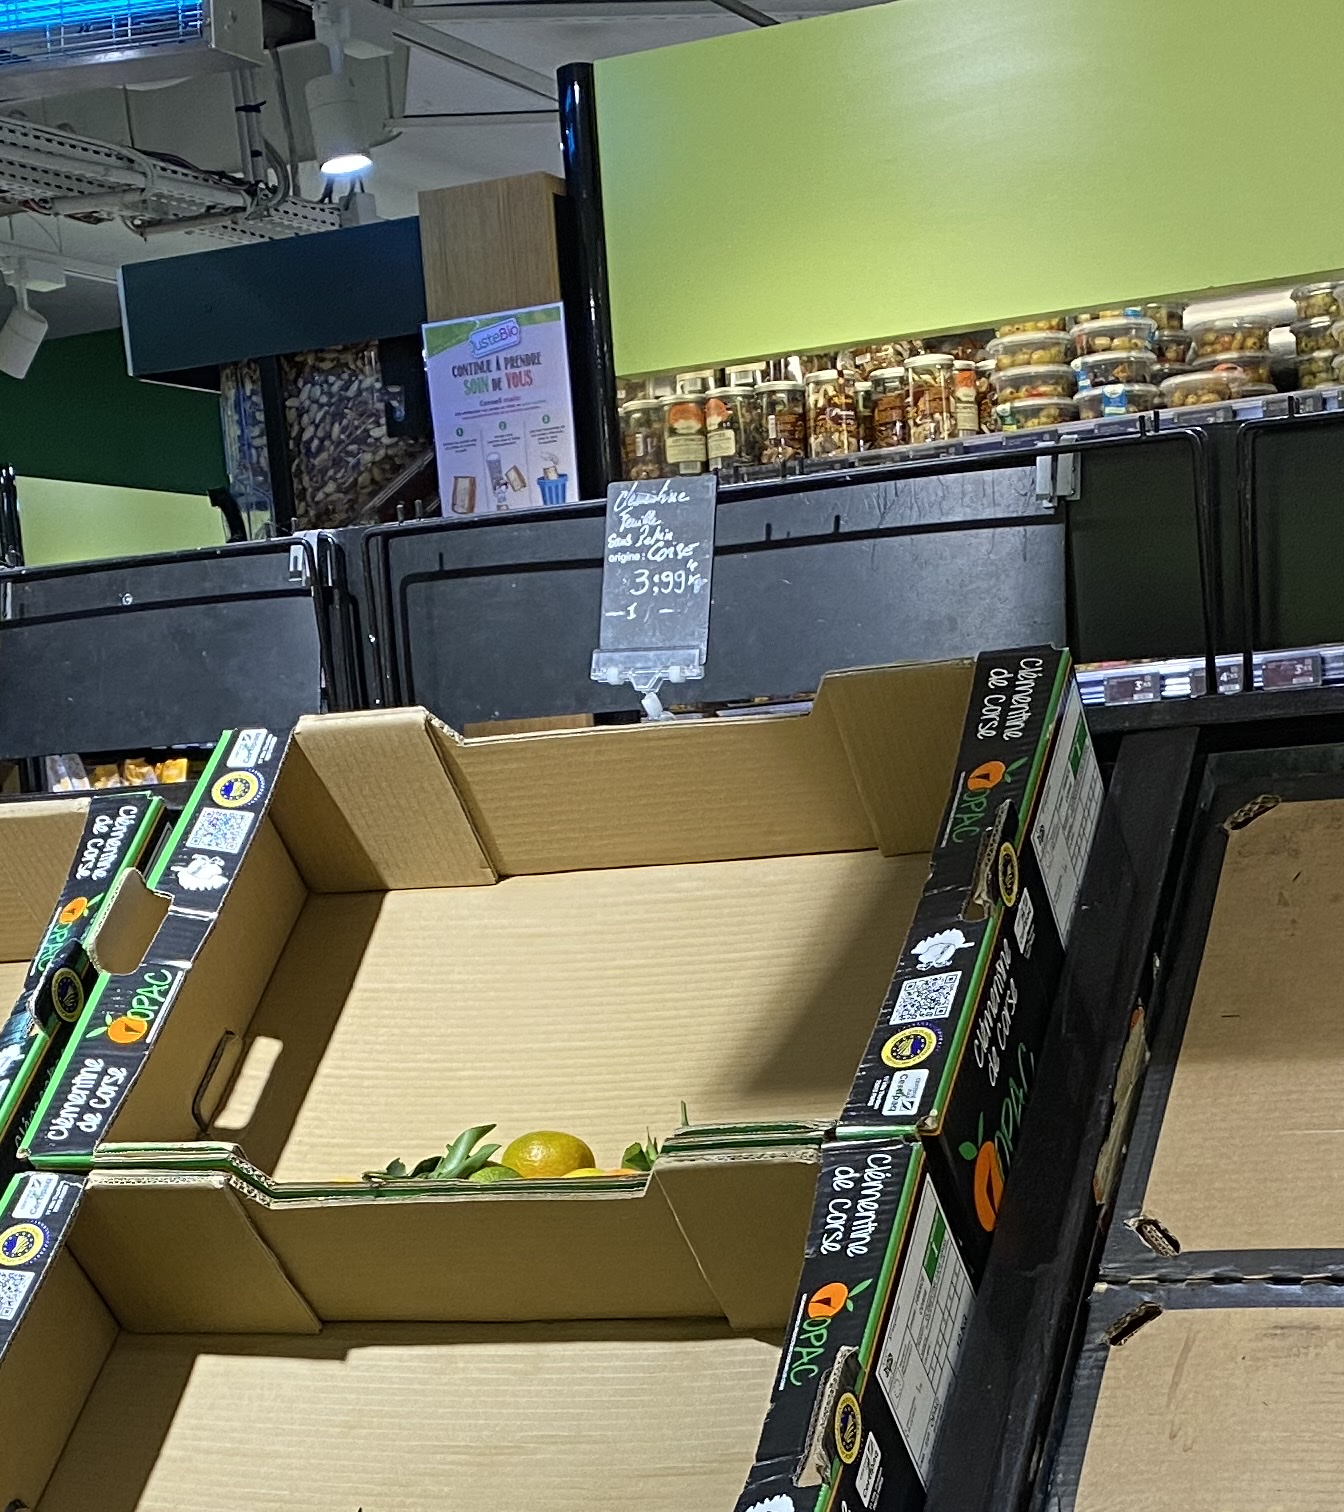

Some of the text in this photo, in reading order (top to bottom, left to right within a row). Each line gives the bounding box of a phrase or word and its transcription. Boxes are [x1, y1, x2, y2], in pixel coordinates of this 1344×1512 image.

[452, 361, 493, 378] CONTINUE
[504, 352, 542, 370] PRENDRE
[464, 370, 533, 395] SOIN DE VOUS
[988, 669, 1008, 689] de
[1003, 658, 1043, 740] Clémentine
[93, 813, 111, 835] de
[953, 790, 990, 843] OPAC
[129, 967, 172, 1022] OPAC
[47, 1057, 104, 1141] Clémentine
[76, 1109, 102, 1133] de
[833, 1166, 859, 1191] de
[846, 1153, 892, 1258] Clémentine
[790, 1316, 831, 1387] OPAC
